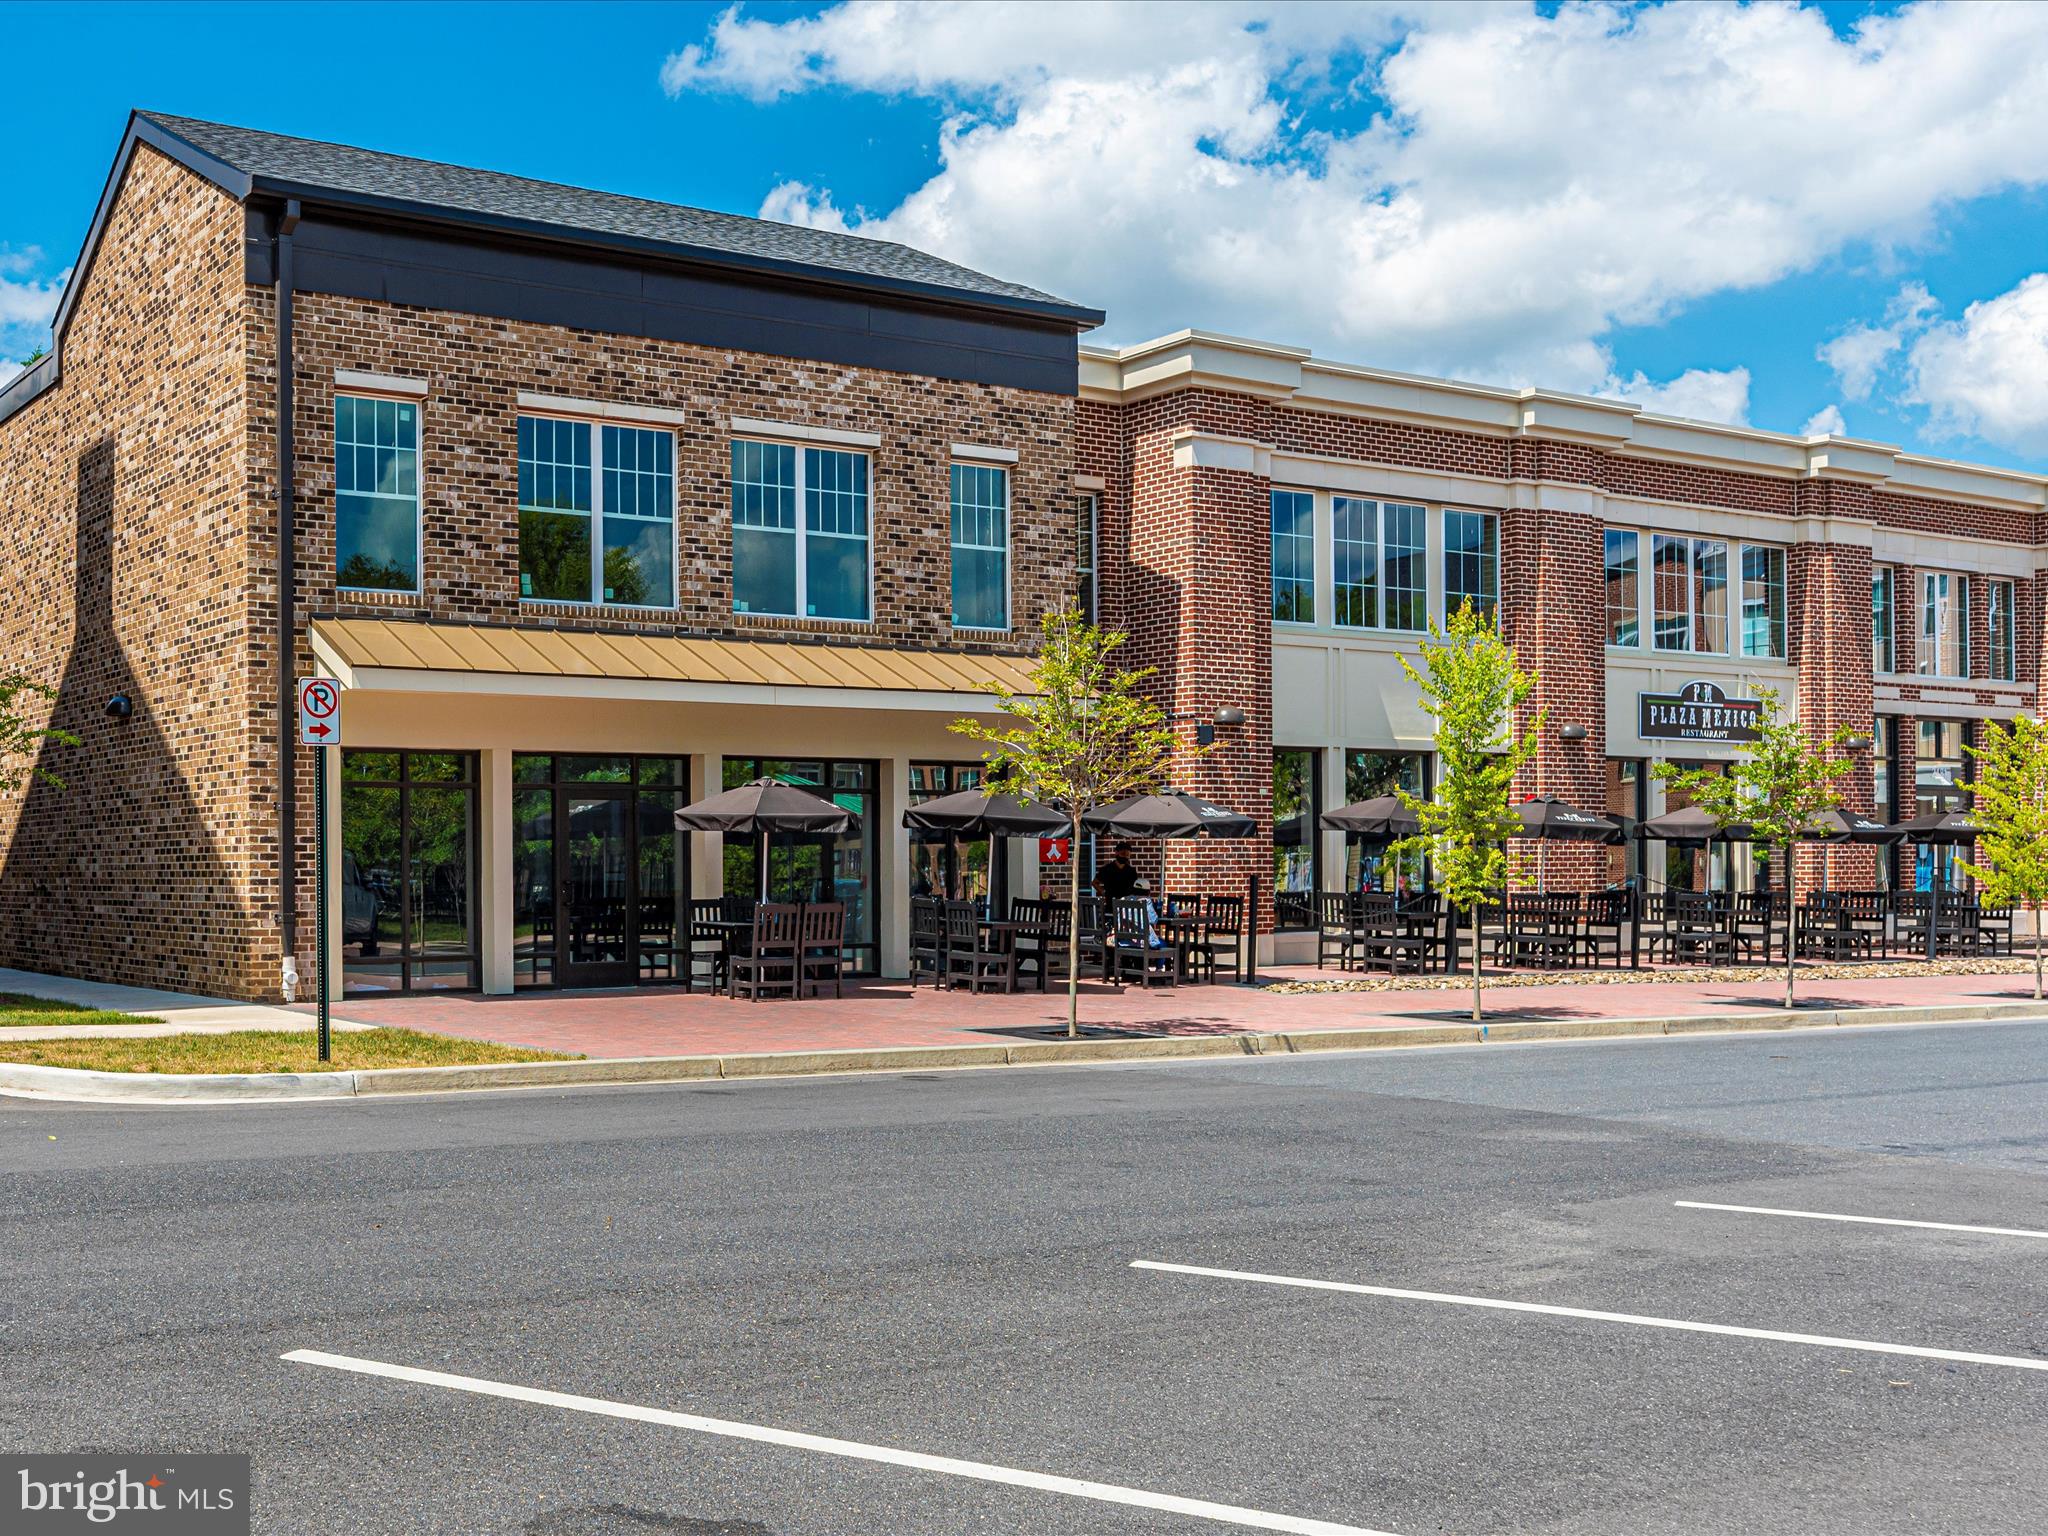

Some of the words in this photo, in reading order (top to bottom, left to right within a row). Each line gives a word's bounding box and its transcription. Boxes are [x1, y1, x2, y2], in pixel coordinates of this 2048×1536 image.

[314, 688, 329, 712] P
[1650, 705, 1697, 726] PLAZA
[1702, 708, 1757, 729] MEXICO
[1681, 729, 1729, 739] RESTAURANT
